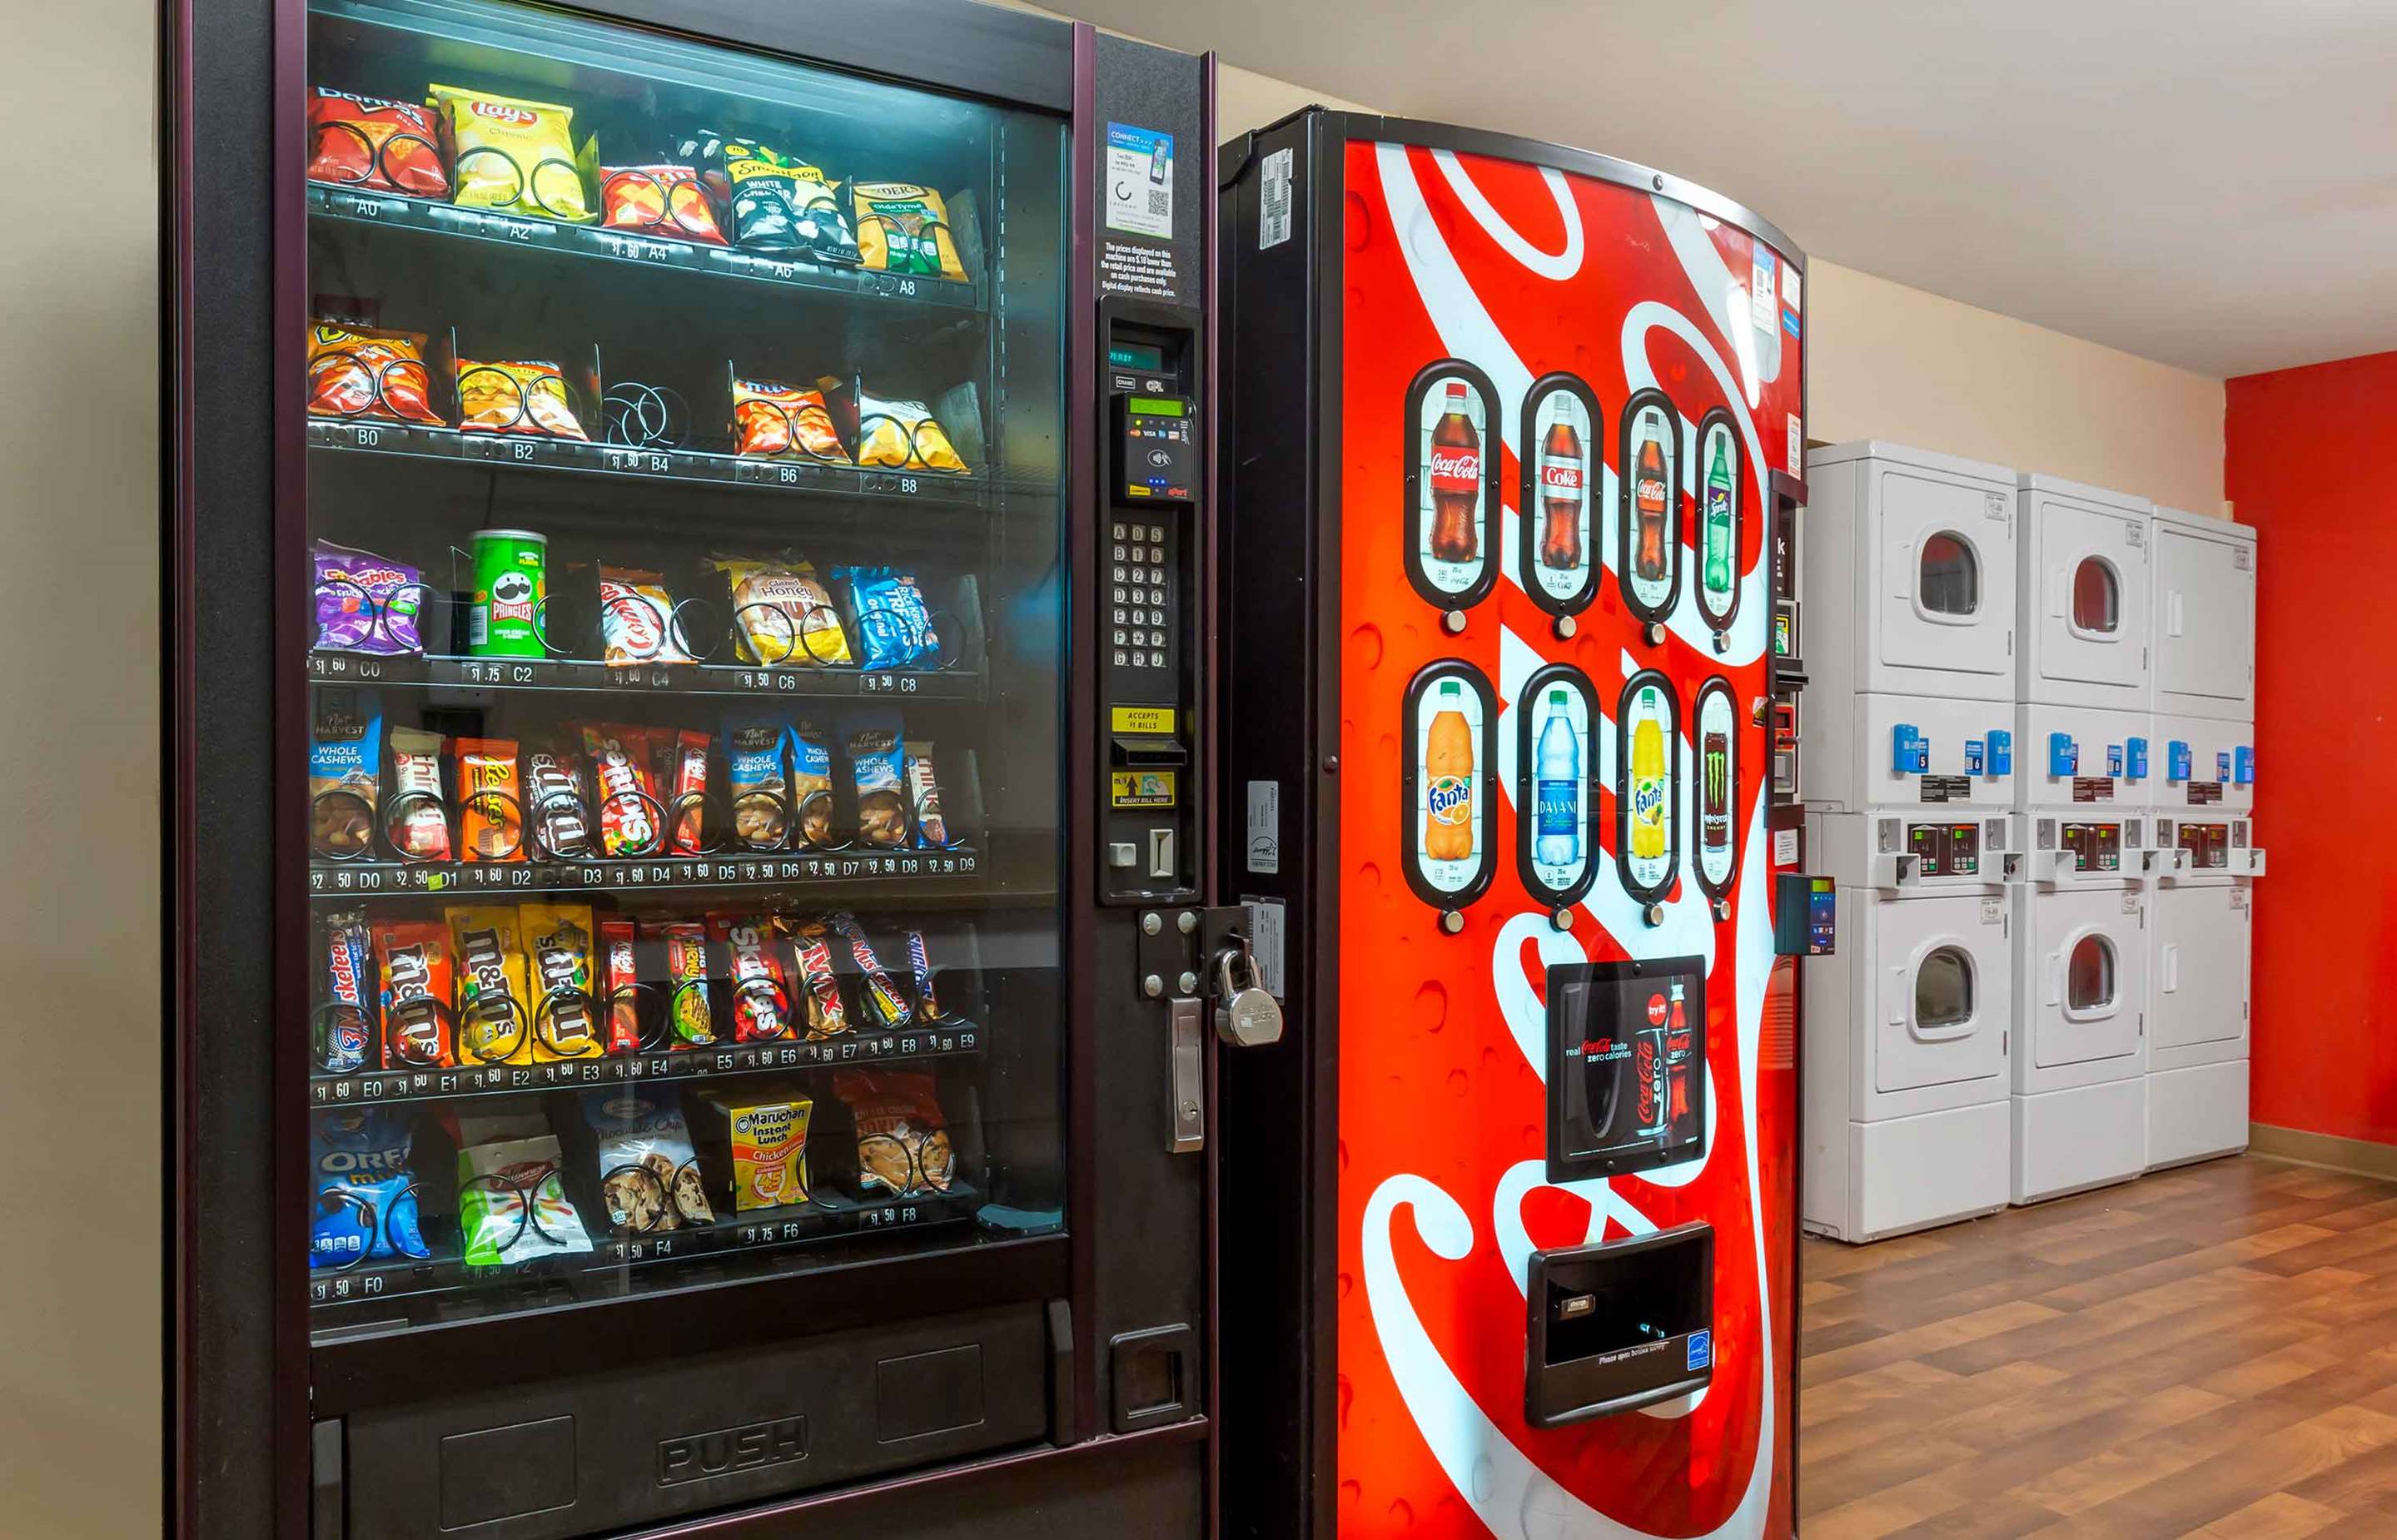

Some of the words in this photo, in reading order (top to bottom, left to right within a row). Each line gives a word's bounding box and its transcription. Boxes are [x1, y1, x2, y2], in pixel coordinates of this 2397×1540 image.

[747, 180, 782, 189] WHITE
[356, 199, 377, 216] A0
[510, 226, 530, 240] A2
[649, 245, 666, 260] A4
[775, 264, 793, 278] A6
[899, 280, 915, 295] A8
[359, 430, 377, 445] B0
[515, 445, 533, 460] B2
[651, 456, 669, 471] B4
[1431, 453, 1479, 479] Coca-Cola
[781, 469, 797, 483] B6
[1546, 468, 1577, 486] Coke
[903, 479, 916, 493] B8
[1637, 479, 1665, 500] Coca-Cola
[761, 584, 813, 600] Honey
[493, 601, 531, 620] PRINGLES
[514, 668, 532, 682] C2
[778, 676, 795, 689] C6
[901, 678, 916, 692] C8
[318, 747, 357, 755] WHOLE
[311, 755, 363, 764] CASHEWS
[738, 756, 771, 764] WHOLE
[855, 758, 888, 766] WHOLE
[1921, 756, 1925, 767] 5
[1975, 759, 1980, 768] 6
[732, 763, 776, 771] CASHEWS
[1430, 785, 1468, 813] Fanta
[1636, 789, 1663, 816] Fanta
[1540, 801, 1577, 814] DASANI
[783, 864, 798, 877] D6
[843, 862, 858, 875] D7
[903, 860, 918, 873] D8
[960, 858, 975, 872] D9
[440, 871, 457, 886] D1
[513, 870, 530, 885] D2
[584, 869, 602, 882] D3
[654, 867, 670, 881] D4
[719, 867, 735, 880] D5
[903, 1039, 916, 1052] E8
[961, 1034, 974, 1047] E9
[843, 1045, 857, 1058] E7
[1566, 1046, 1580, 1056] real
[1611, 1043, 1628, 1051] taste
[1588, 1053, 1604, 1062] zero
[1605, 1050, 1632, 1060] calories
[1671, 1049, 1685, 1059] zero
[717, 1055, 733, 1069] E5
[781, 1050, 796, 1064] E6
[584, 1066, 599, 1080] E3
[652, 1061, 668, 1075] E4
[441, 1077, 457, 1091] E1
[513, 1071, 530, 1085] E2
[1636, 1041, 1654, 1124] Coca-Cola
[749, 1110, 804, 1125] Maruchan
[753, 1124, 791, 1135] Instant
[758, 1134, 787, 1145] Lunch
[753, 1146, 789, 1160] Chicken
[903, 1208, 916, 1221] F8
[784, 1224, 798, 1238] F6
[657, 1240, 671, 1255] F4
[662, 1423, 803, 1482] PUSH
